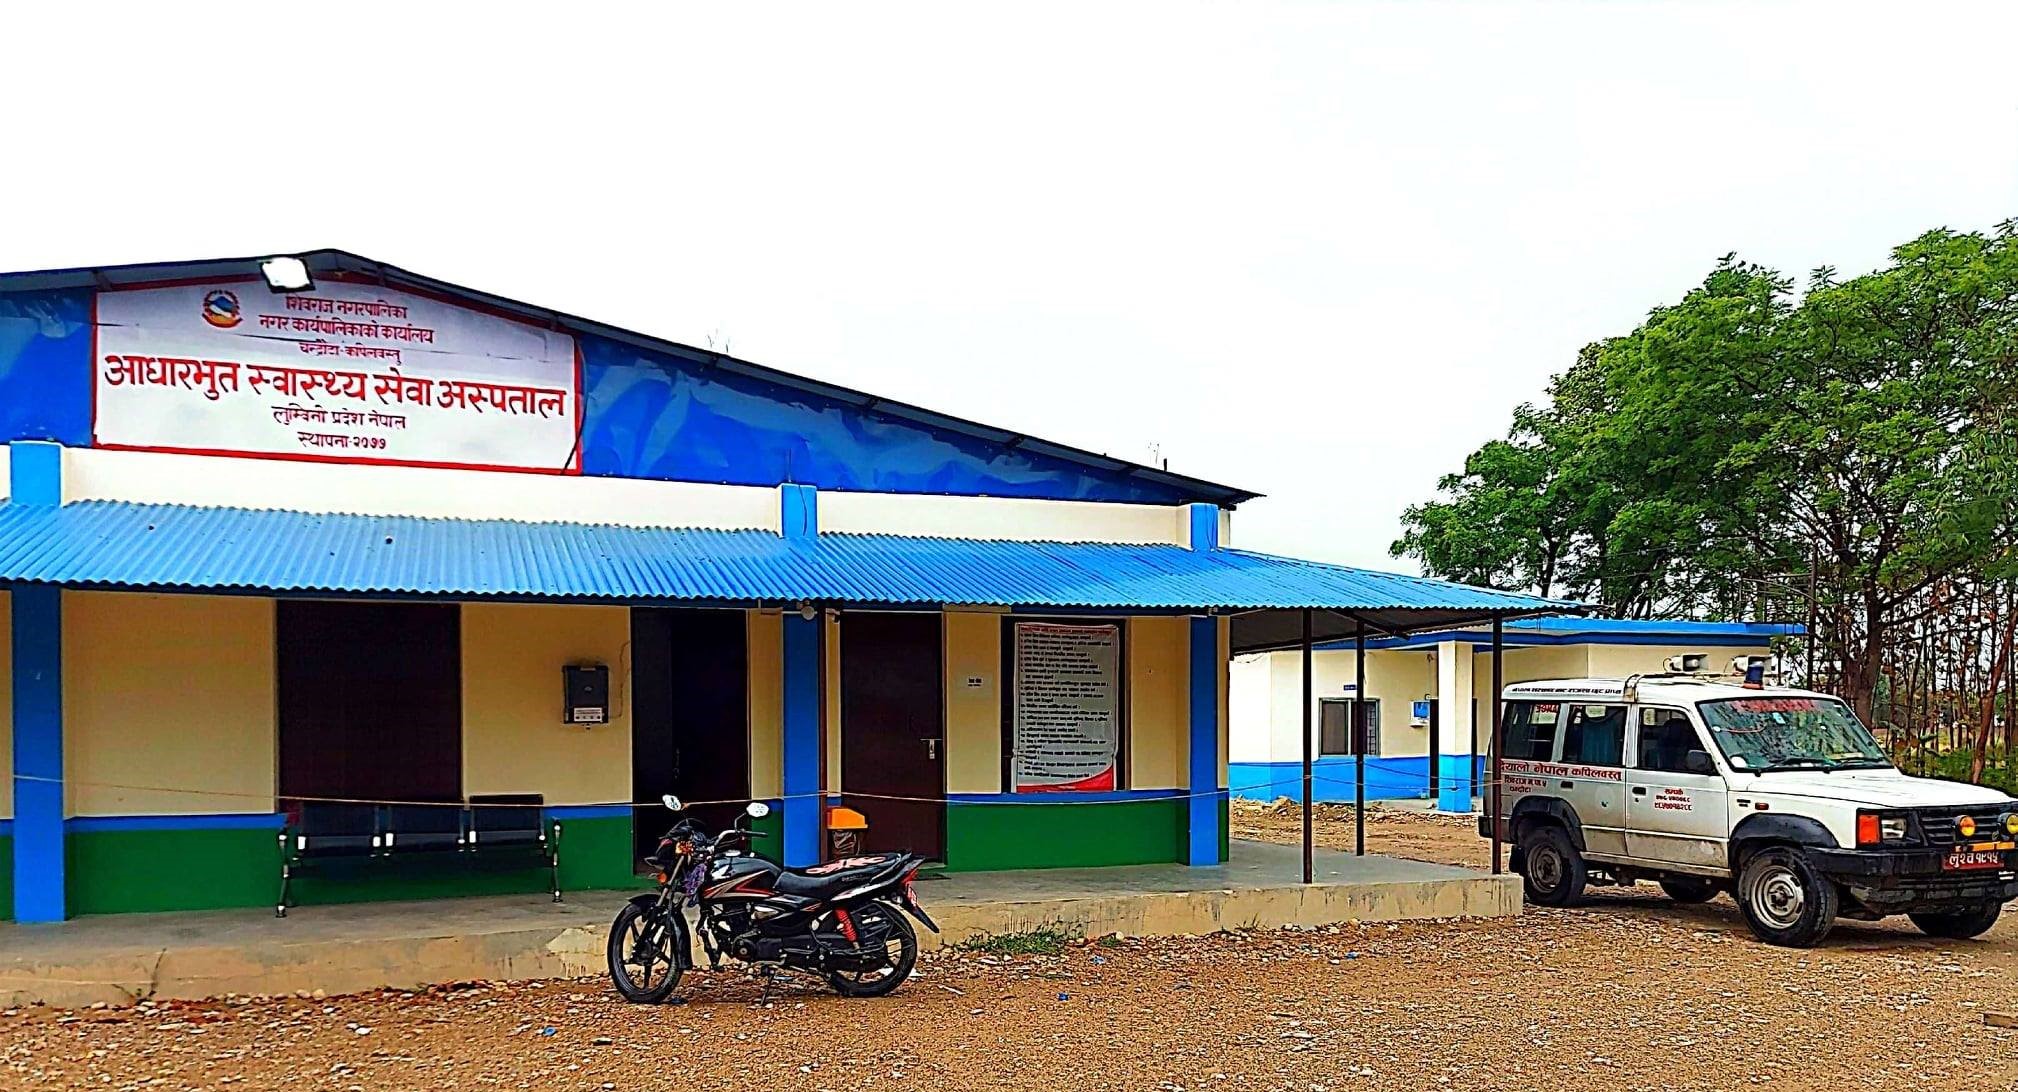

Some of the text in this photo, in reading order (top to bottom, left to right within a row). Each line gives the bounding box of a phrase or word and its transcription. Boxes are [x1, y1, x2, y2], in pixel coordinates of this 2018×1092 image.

[336, 300, 407, 319] नगरपालिका
[259, 315, 290, 331] नगर
[381, 324, 434, 343] कार्यालय
[105, 354, 567, 418] आधारभुत स्वास्थ्य सेवा अस्पताल
[331, 408, 365, 425] प्रदेश
[368, 409, 406, 429] नेपाल
